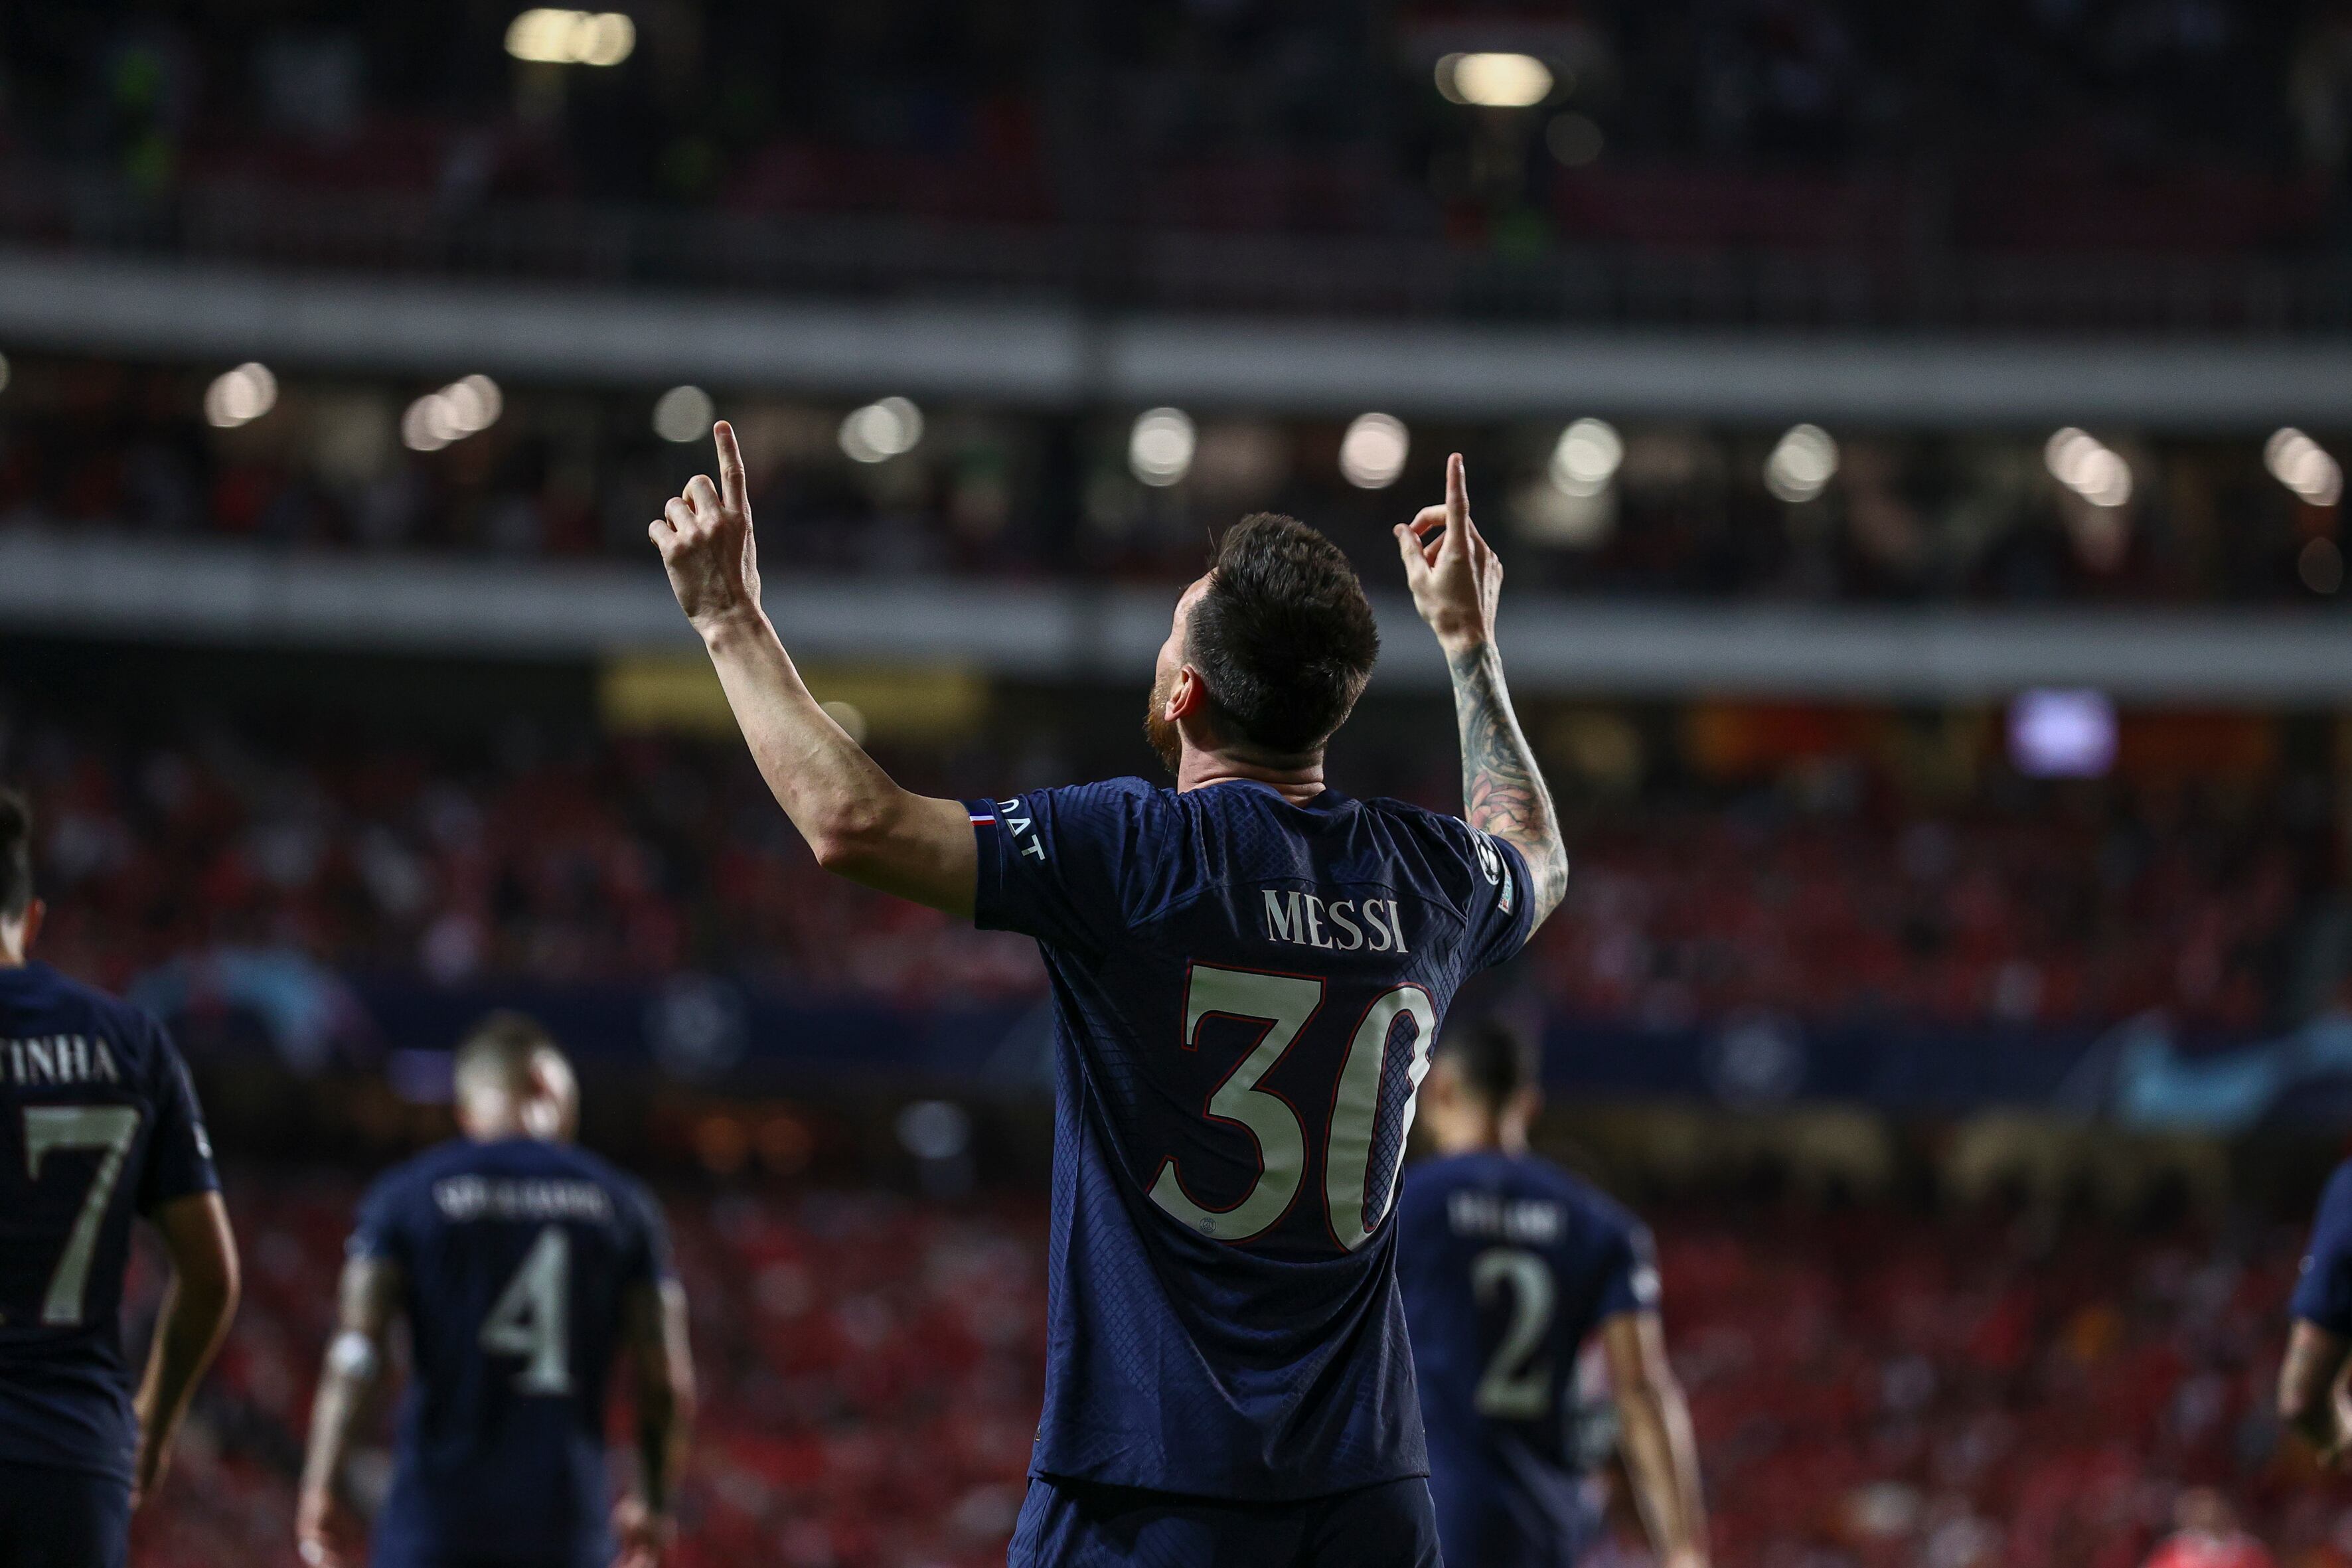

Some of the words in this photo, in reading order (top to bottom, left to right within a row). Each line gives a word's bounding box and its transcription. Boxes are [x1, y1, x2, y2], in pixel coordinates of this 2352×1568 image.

[1262, 889, 1409, 953] MESSI
[1146, 959, 1437, 1254] 30
[478, 1225, 575, 1394] 4
[1471, 1248, 1555, 1418] 2
